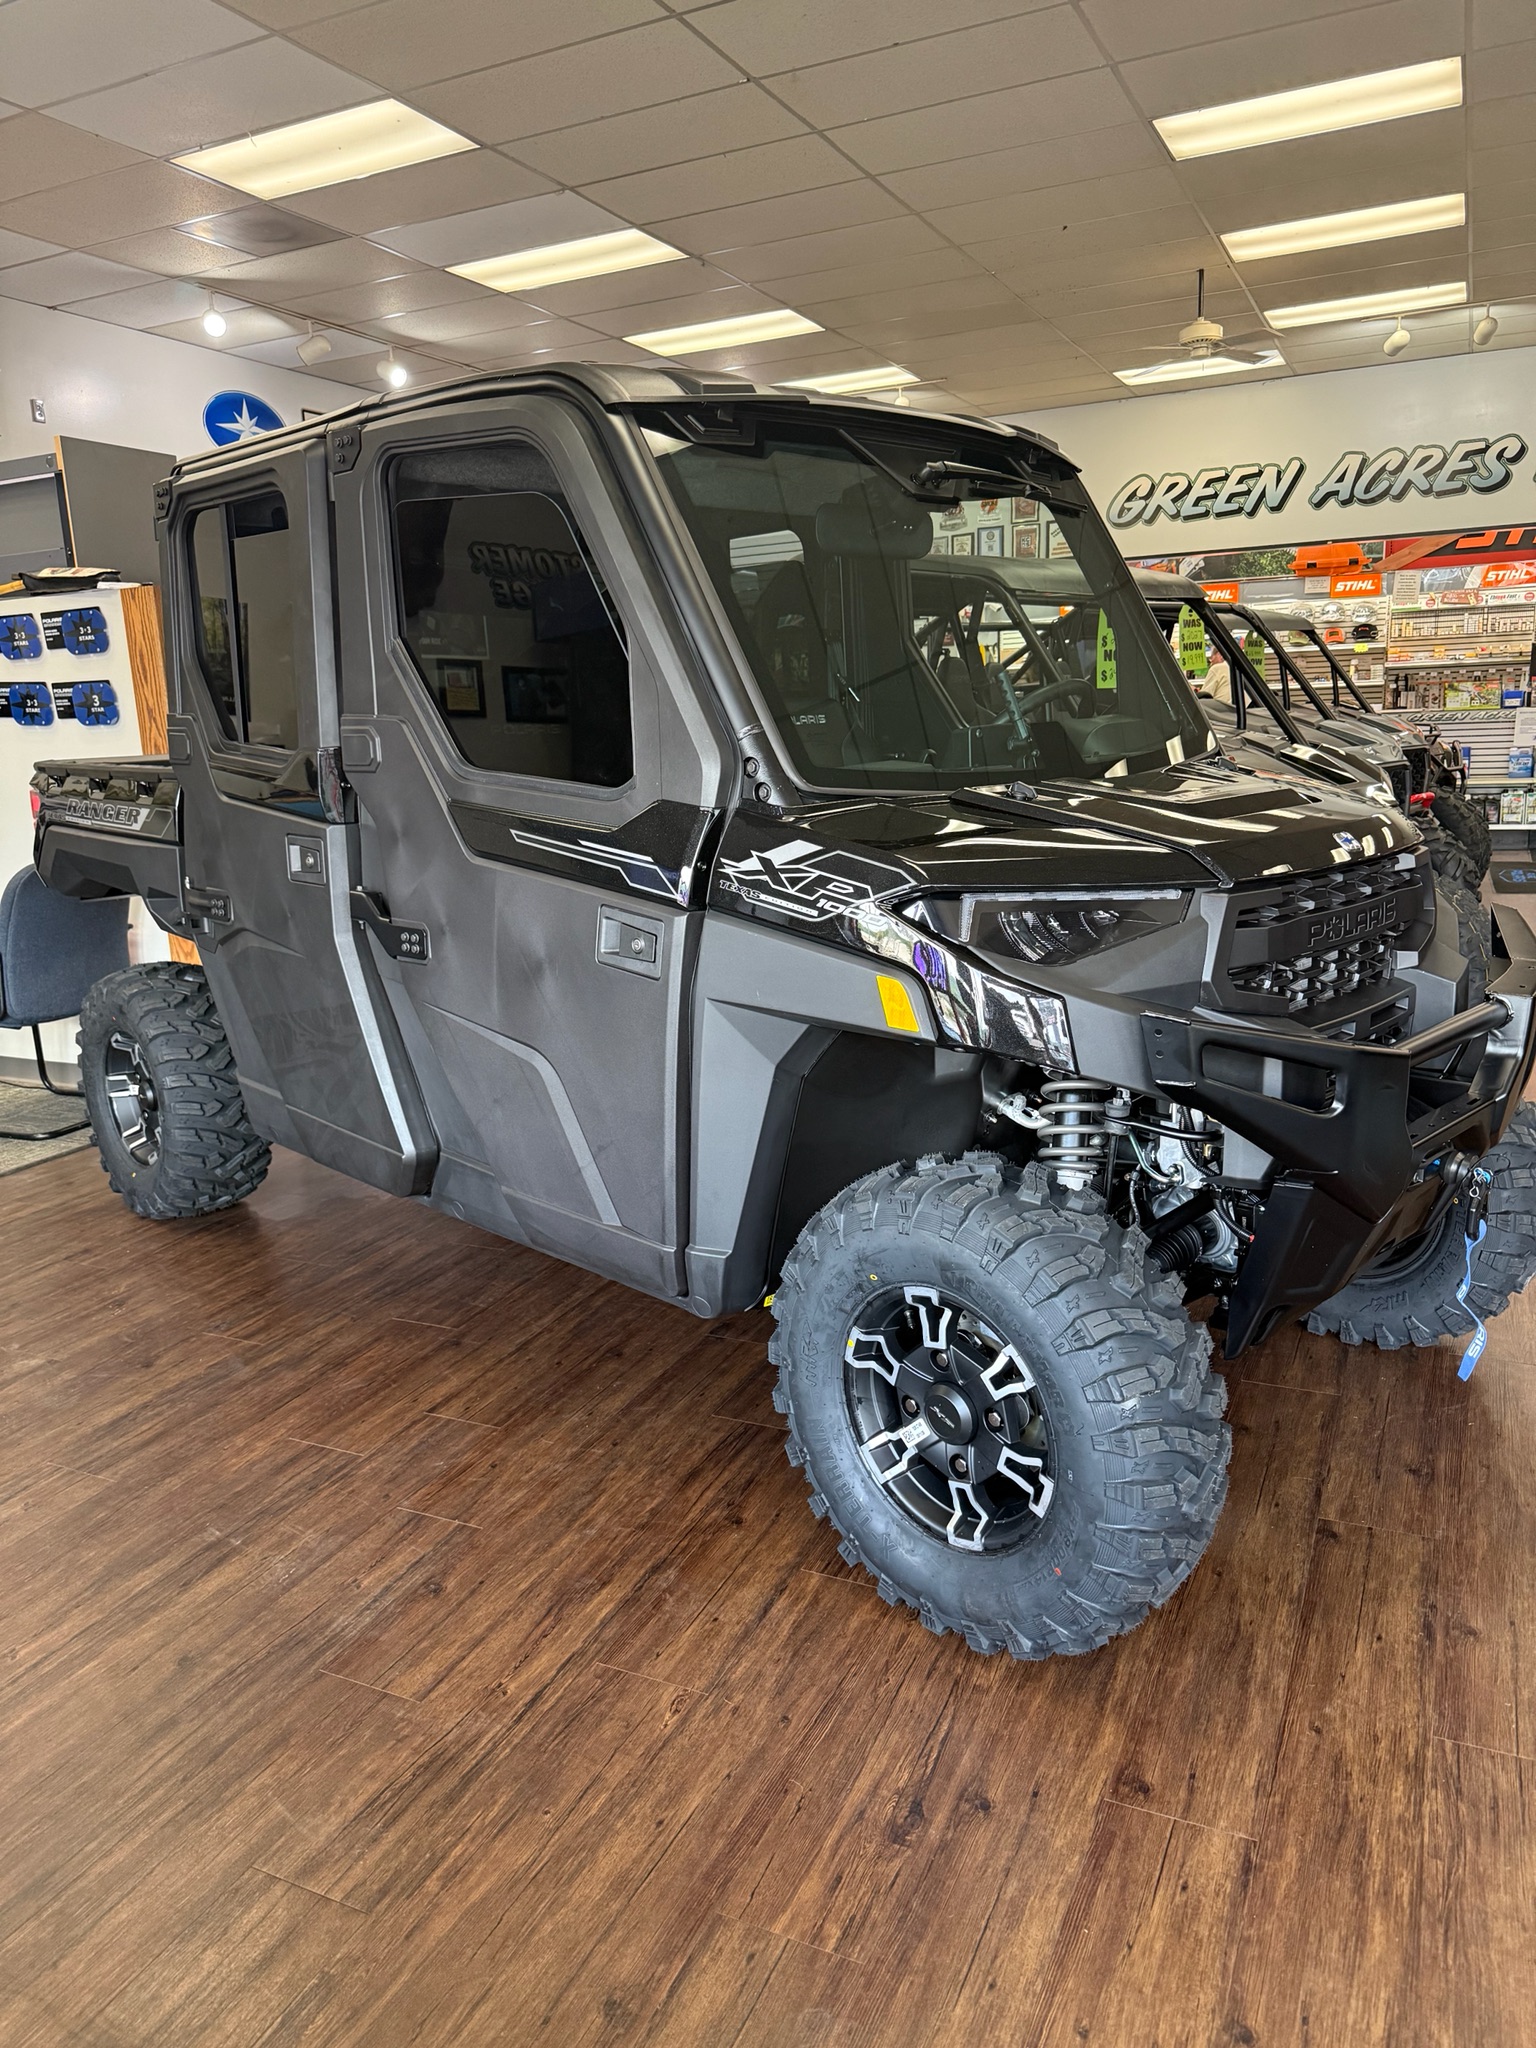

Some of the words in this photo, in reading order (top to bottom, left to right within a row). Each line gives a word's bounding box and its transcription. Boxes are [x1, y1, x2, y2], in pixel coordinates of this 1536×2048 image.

[1106, 456, 1307, 529] GREEN
[1308, 432, 1529, 510] ACRES
[1486, 568, 1531, 582] STIHL
[1334, 579, 1377, 592] STIHL
[1204, 588, 1234, 600] TIHL
[1183, 618, 1201, 628] WAS
[1183, 641, 1203, 651] NOW
[1247, 640, 1263, 648] WAS
[92, 695, 100, 706] 3
[1407, 711, 1467, 723] GREEN
[1470, 709, 1517, 722] ACRE
[65, 798, 142, 826] RANGER
[719, 879, 763, 900] TEXAS
[815, 898, 889, 926] 1000
[1307, 898, 1397, 947] POLARIS
